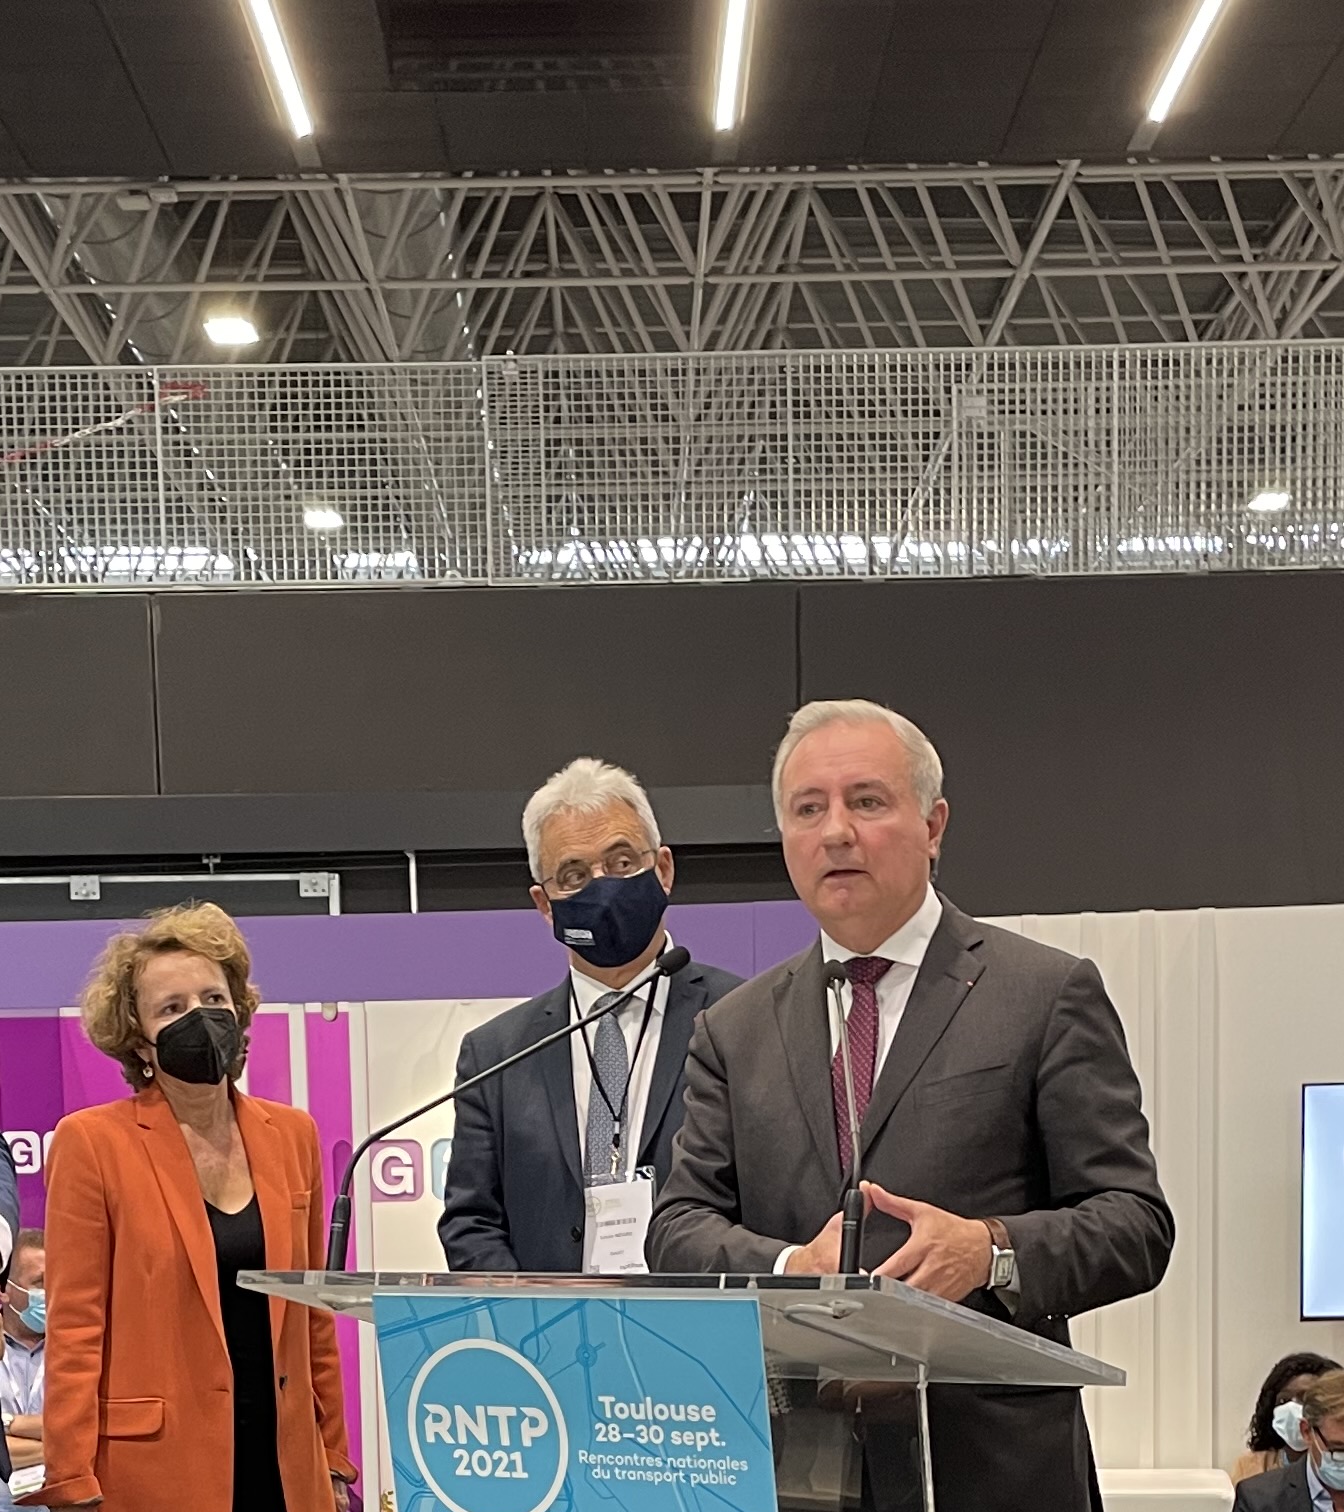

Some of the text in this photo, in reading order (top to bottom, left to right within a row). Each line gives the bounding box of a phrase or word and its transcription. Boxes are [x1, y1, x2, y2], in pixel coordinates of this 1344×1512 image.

[597, 1395, 717, 1422] Toulouse
[423, 1403, 549, 1447] RNTP
[670, 1428, 727, 1452] sept.
[453, 1448, 529, 1479] 2021
[578, 1449, 749, 1472] Rencontres nationales
[591, 1465, 738, 1487] du transport public
